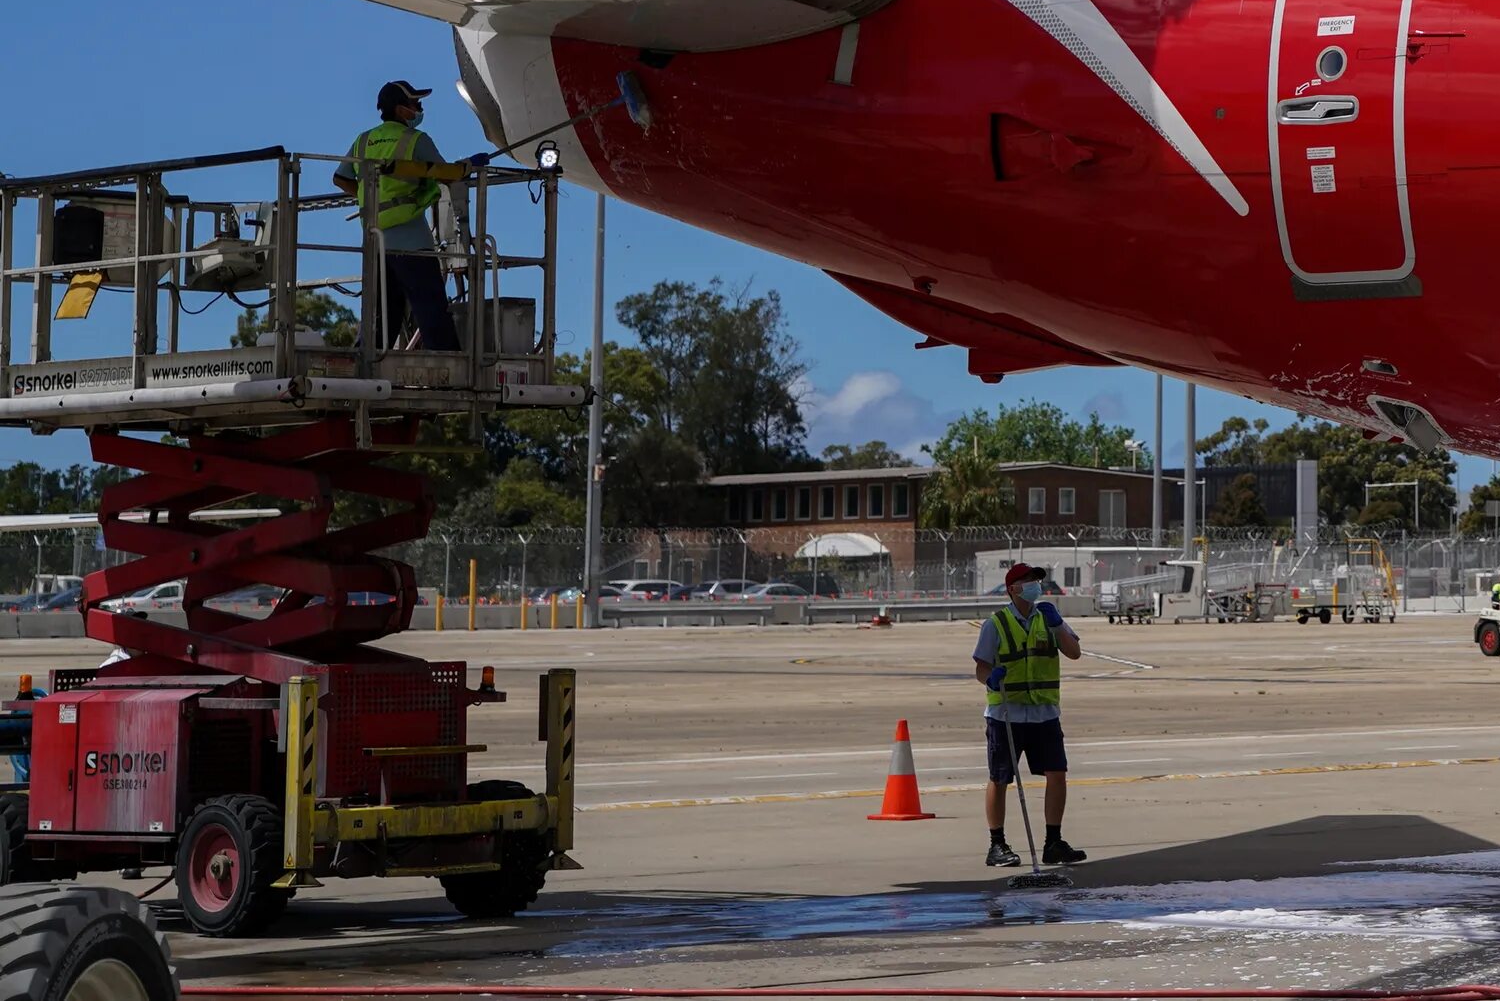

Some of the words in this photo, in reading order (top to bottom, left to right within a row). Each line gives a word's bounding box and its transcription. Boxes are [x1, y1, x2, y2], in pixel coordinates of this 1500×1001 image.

[1319, 19, 1354, 27] EMERGENCY
[152, 359, 273, 381] www.snorkellifts.com
[25, 371, 77, 393] snorkel
[100, 750, 167, 774] snorkel
